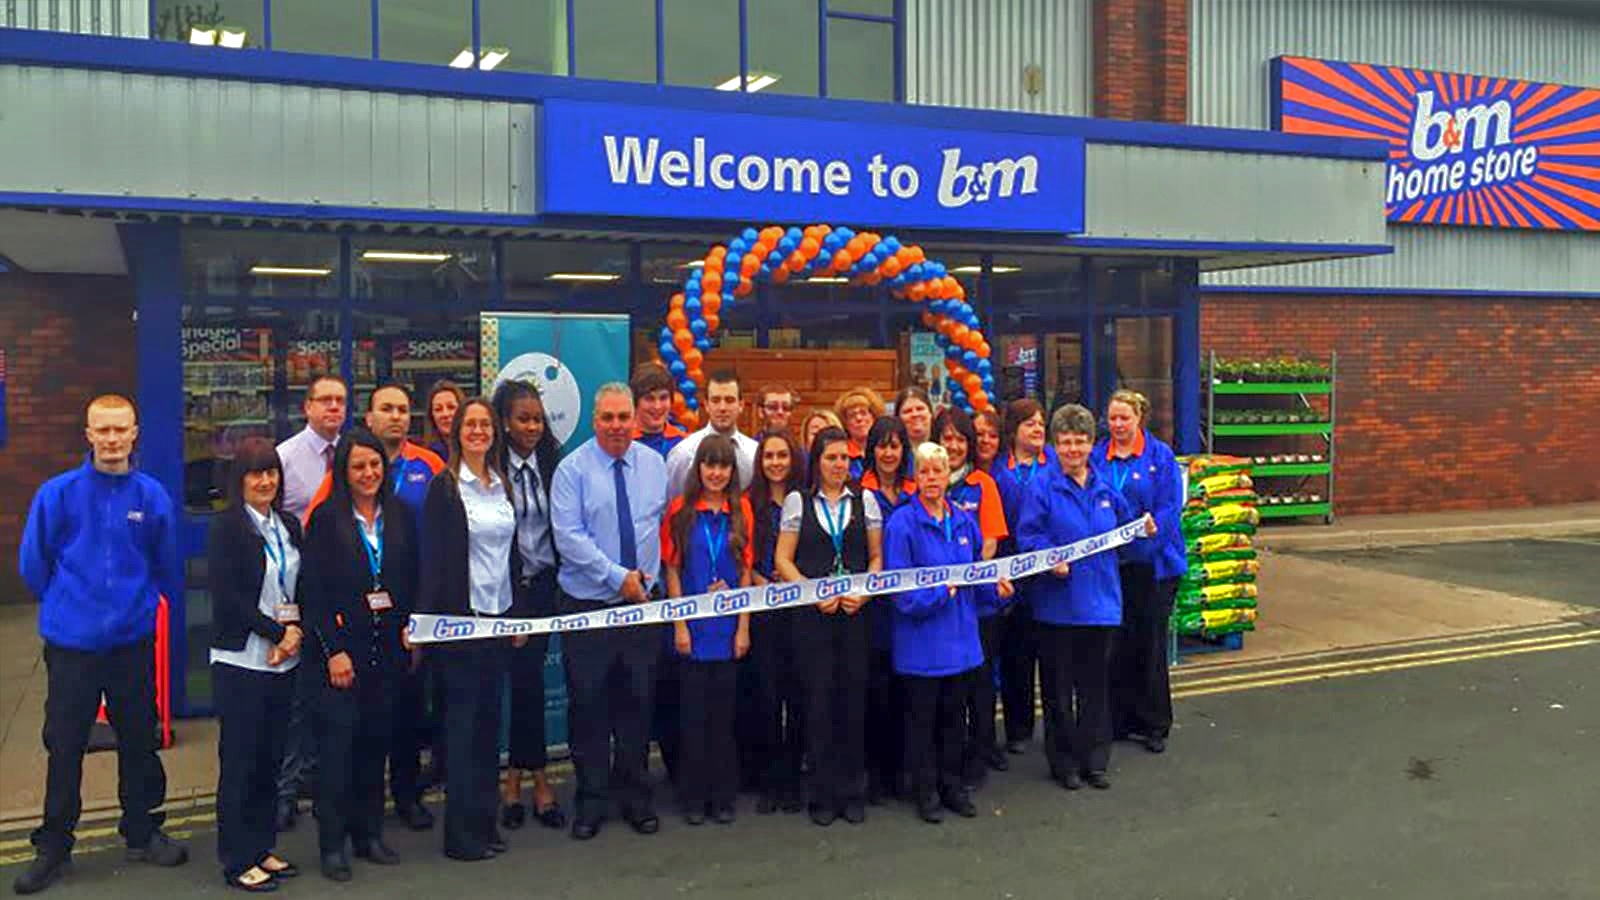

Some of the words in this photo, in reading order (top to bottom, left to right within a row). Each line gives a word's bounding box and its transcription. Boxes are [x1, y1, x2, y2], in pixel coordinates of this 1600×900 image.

[1412, 90, 1512, 161] b&m
[603, 135, 852, 196] Welcome
[867, 153, 920, 199] to
[937, 148, 1039, 208] b&m
[1386, 163, 1463, 203] home
[1470, 145, 1538, 187] store
